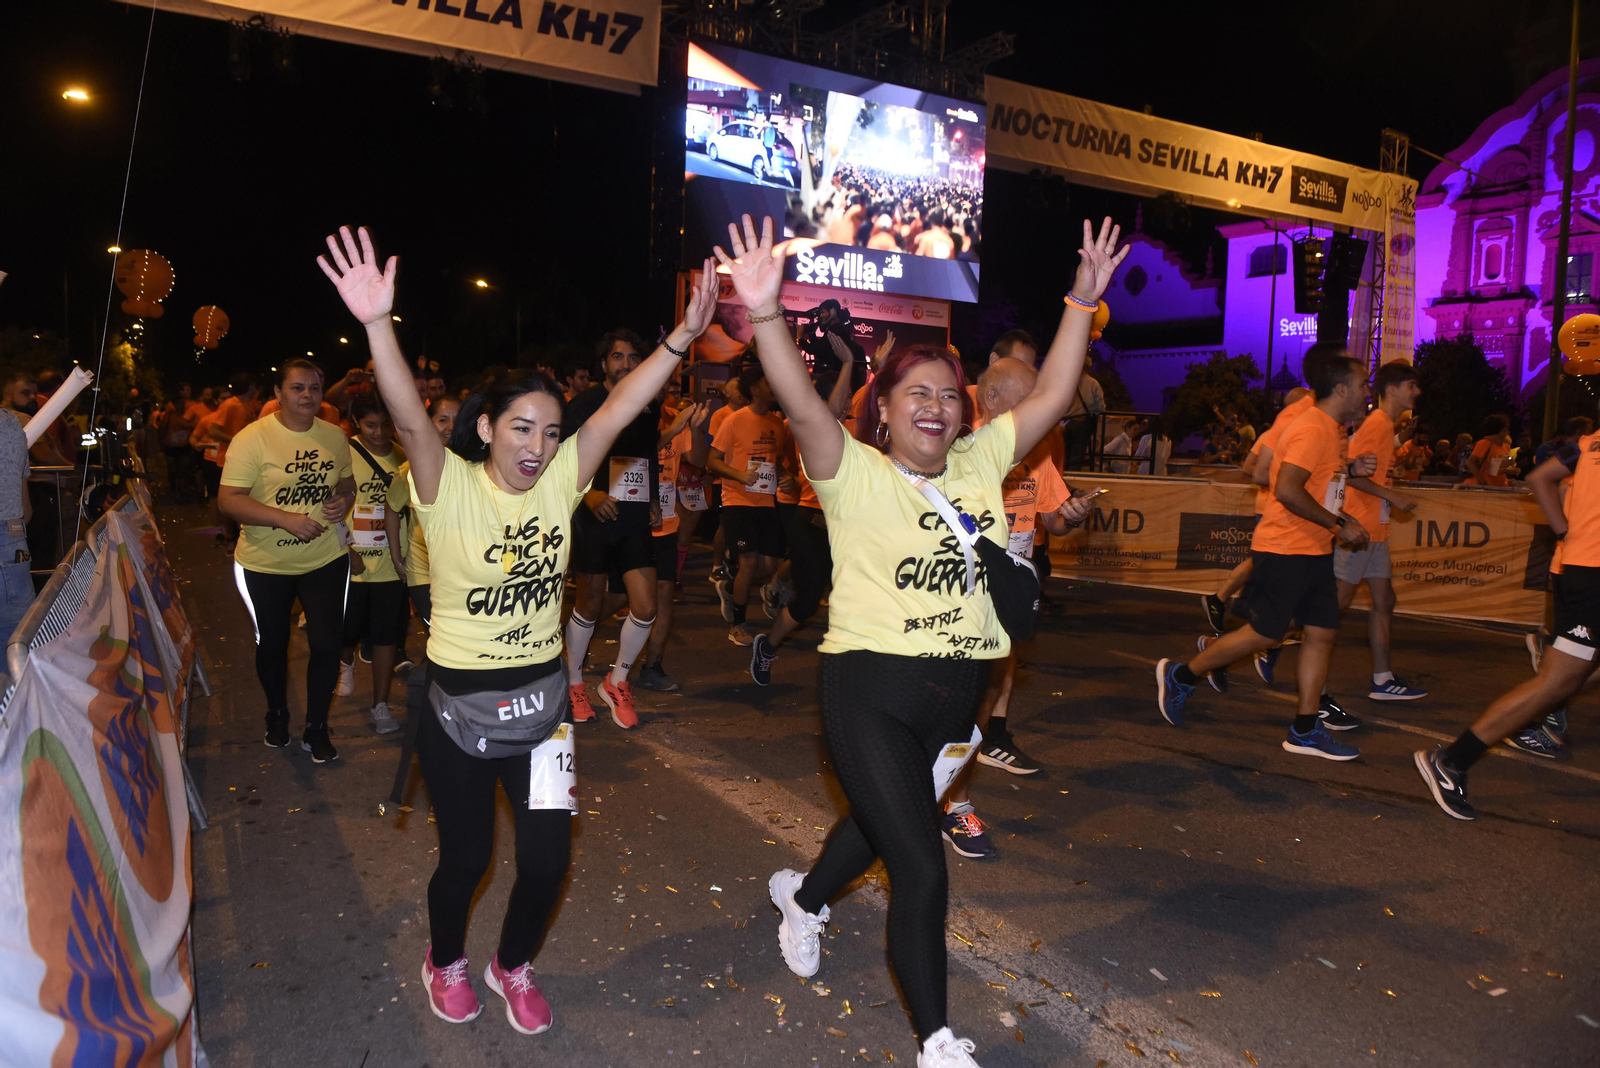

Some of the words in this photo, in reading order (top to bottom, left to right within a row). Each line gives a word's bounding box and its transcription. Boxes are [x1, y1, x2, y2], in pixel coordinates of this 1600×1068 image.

[990, 103, 1131, 160] NOCTURNA
[1137, 138, 1229, 181] SEVILLA
[1280, 317, 1318, 333] Sevill
[295, 449, 319, 461] LAS
[284, 460, 335, 474] CHICAS
[295, 472, 328, 486] SON
[623, 471, 644, 484] 3329
[503, 516, 540, 542] LAS
[1415, 519, 1491, 549] IMD
[1077, 557, 1091, 566] de
[1107, 547, 1162, 561] Municipal
[1204, 553, 1217, 562] DE
[502, 553, 558, 584] SON
[1443, 559, 1508, 575] Municipal
[1403, 570, 1421, 582] de
[1424, 571, 1486, 588] Deportes
[903, 606, 964, 634] BEATRIZ
